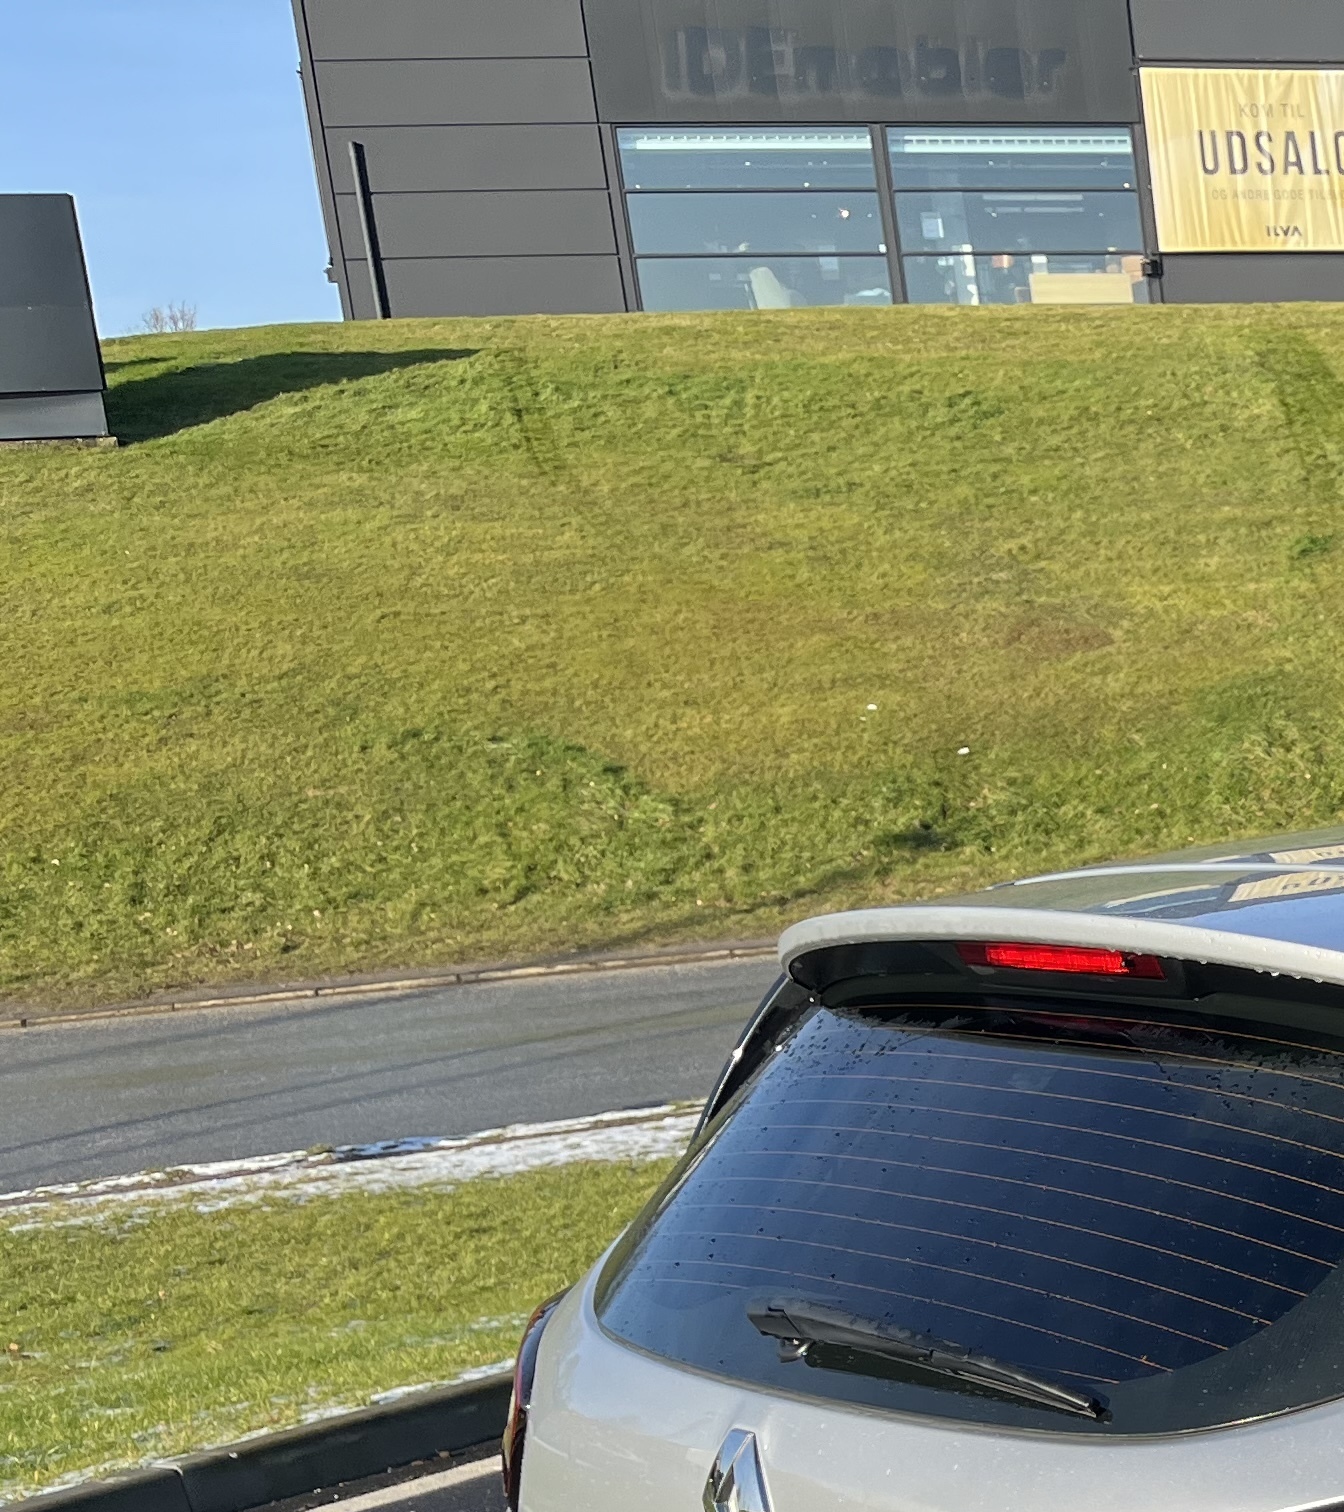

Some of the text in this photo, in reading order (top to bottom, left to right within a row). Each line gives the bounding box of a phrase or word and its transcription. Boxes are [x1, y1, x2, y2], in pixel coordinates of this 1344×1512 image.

[1239, 103, 1305, 118] KOM TIL
[1265, 225, 1302, 237] ILVA
